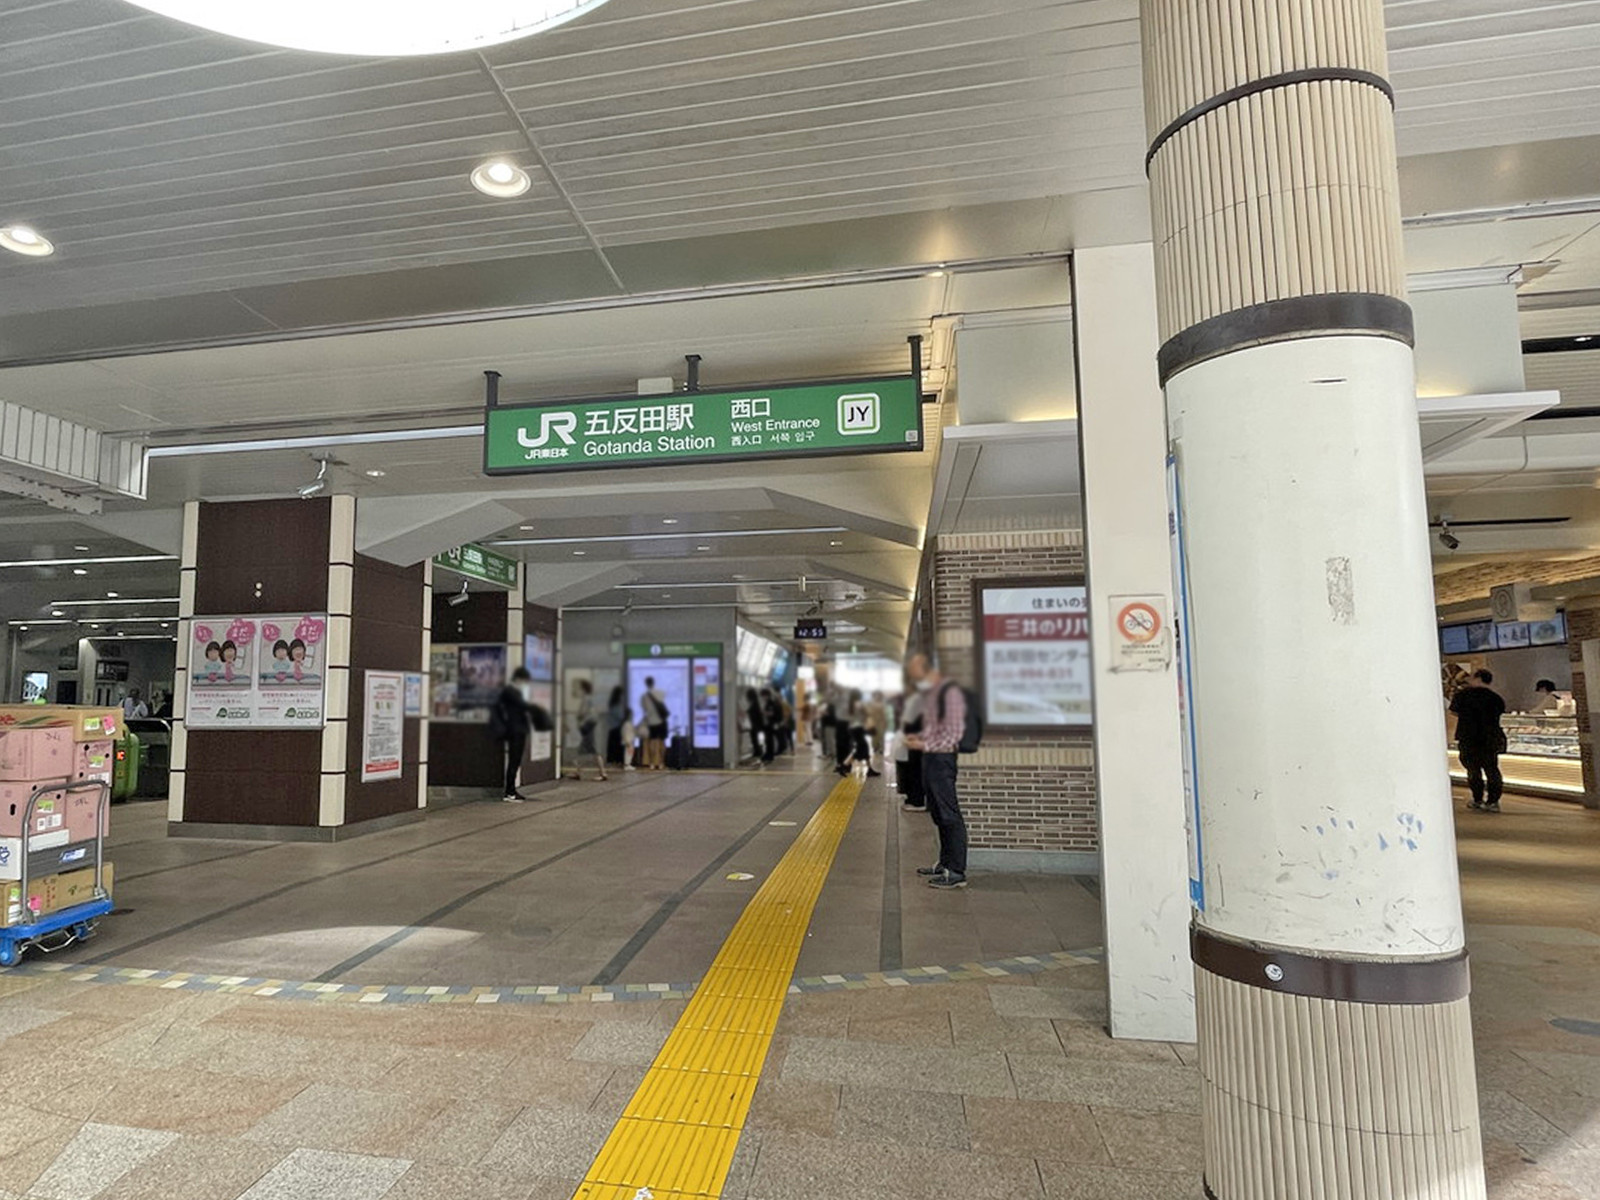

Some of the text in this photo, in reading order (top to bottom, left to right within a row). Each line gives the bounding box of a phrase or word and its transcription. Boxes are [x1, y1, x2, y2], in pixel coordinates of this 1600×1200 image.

[731, 398, 770, 418] 西口
[848, 406, 870, 422] JY
[517, 411, 577, 448] JR
[584, 403, 694, 436] 五反田駅
[731, 417, 820, 433] West Entrance
[525, 448, 569, 460] JR東日本
[584, 434, 715, 457] Gotanda Station
